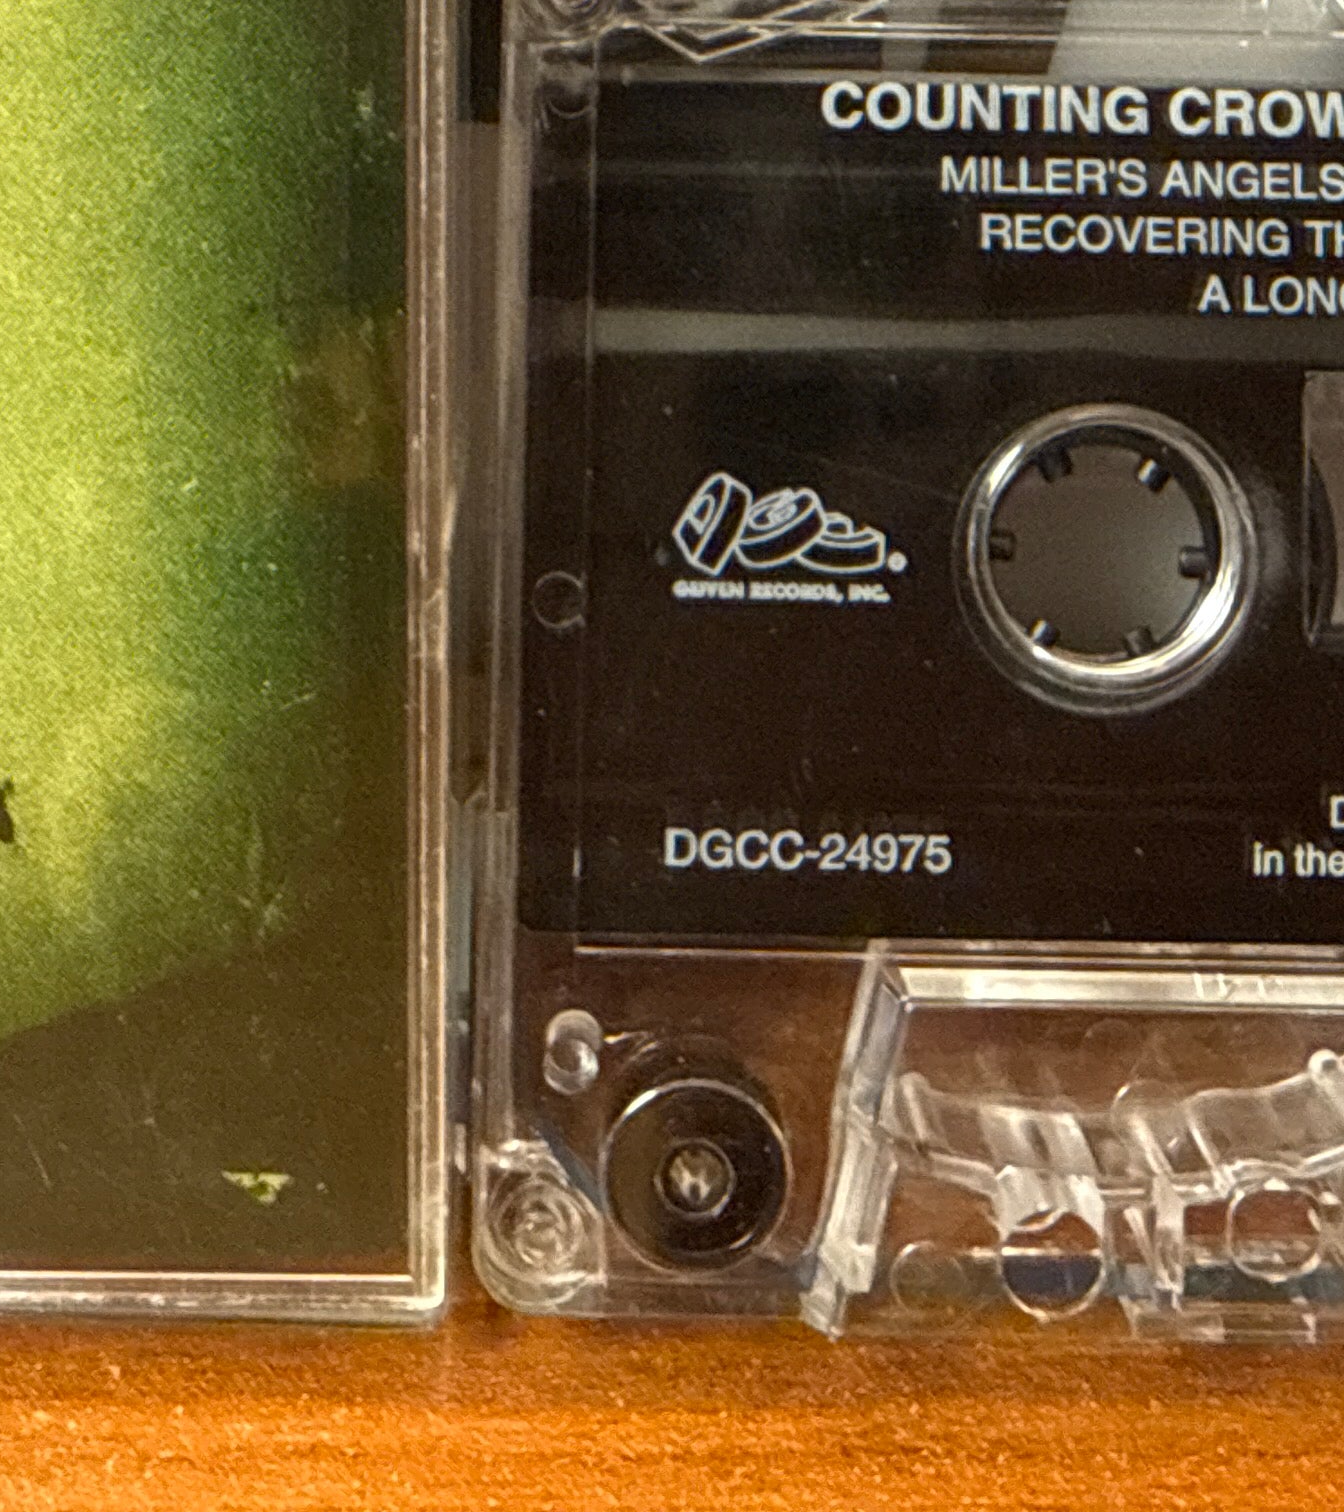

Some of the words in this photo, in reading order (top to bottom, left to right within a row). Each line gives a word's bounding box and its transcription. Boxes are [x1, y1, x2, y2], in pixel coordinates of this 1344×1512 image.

[820, 80, 1150, 136] COUNTING
[941, 155, 1148, 197] MILLER'S
[981, 213, 1290, 257] RECOVERING
[1197, 274, 1231, 313] A
[664, 827, 952, 874] DGCC-24975
